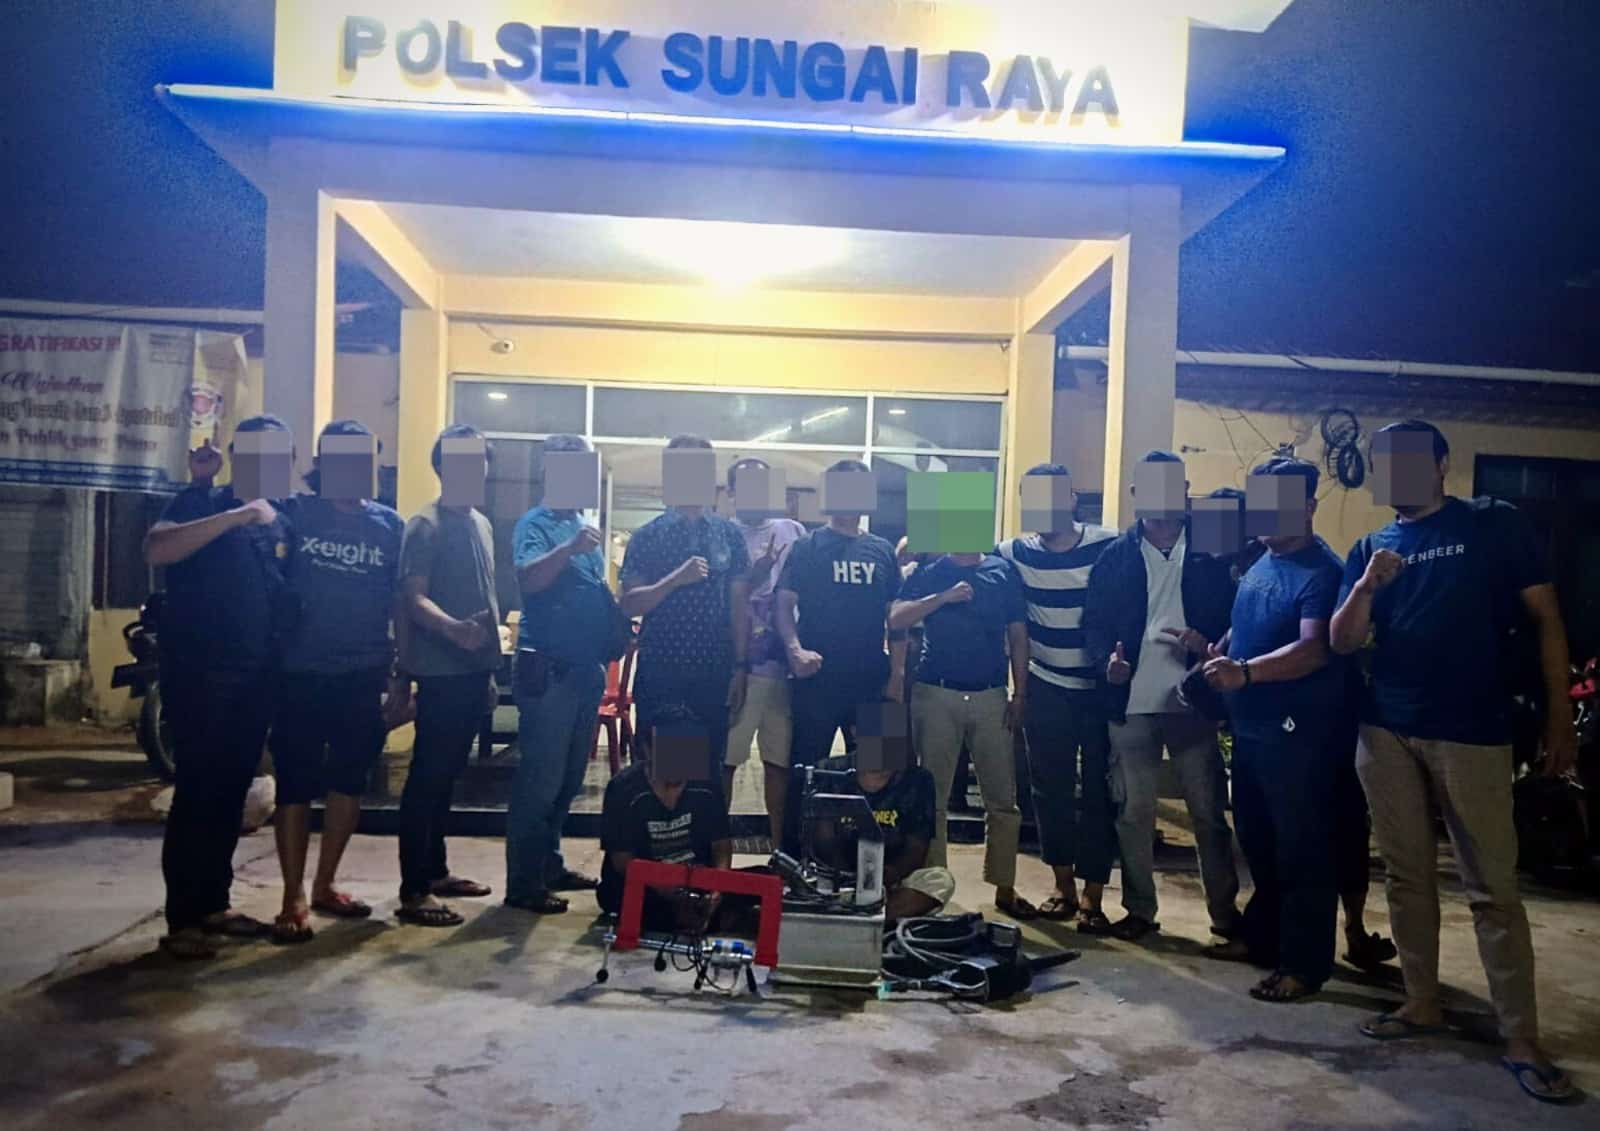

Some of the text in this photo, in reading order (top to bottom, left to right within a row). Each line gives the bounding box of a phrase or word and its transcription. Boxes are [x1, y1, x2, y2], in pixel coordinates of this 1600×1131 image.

[343, 15, 1120, 115] POLSEK SUNGAI RAYA
[833, 560, 875, 585] HEY
